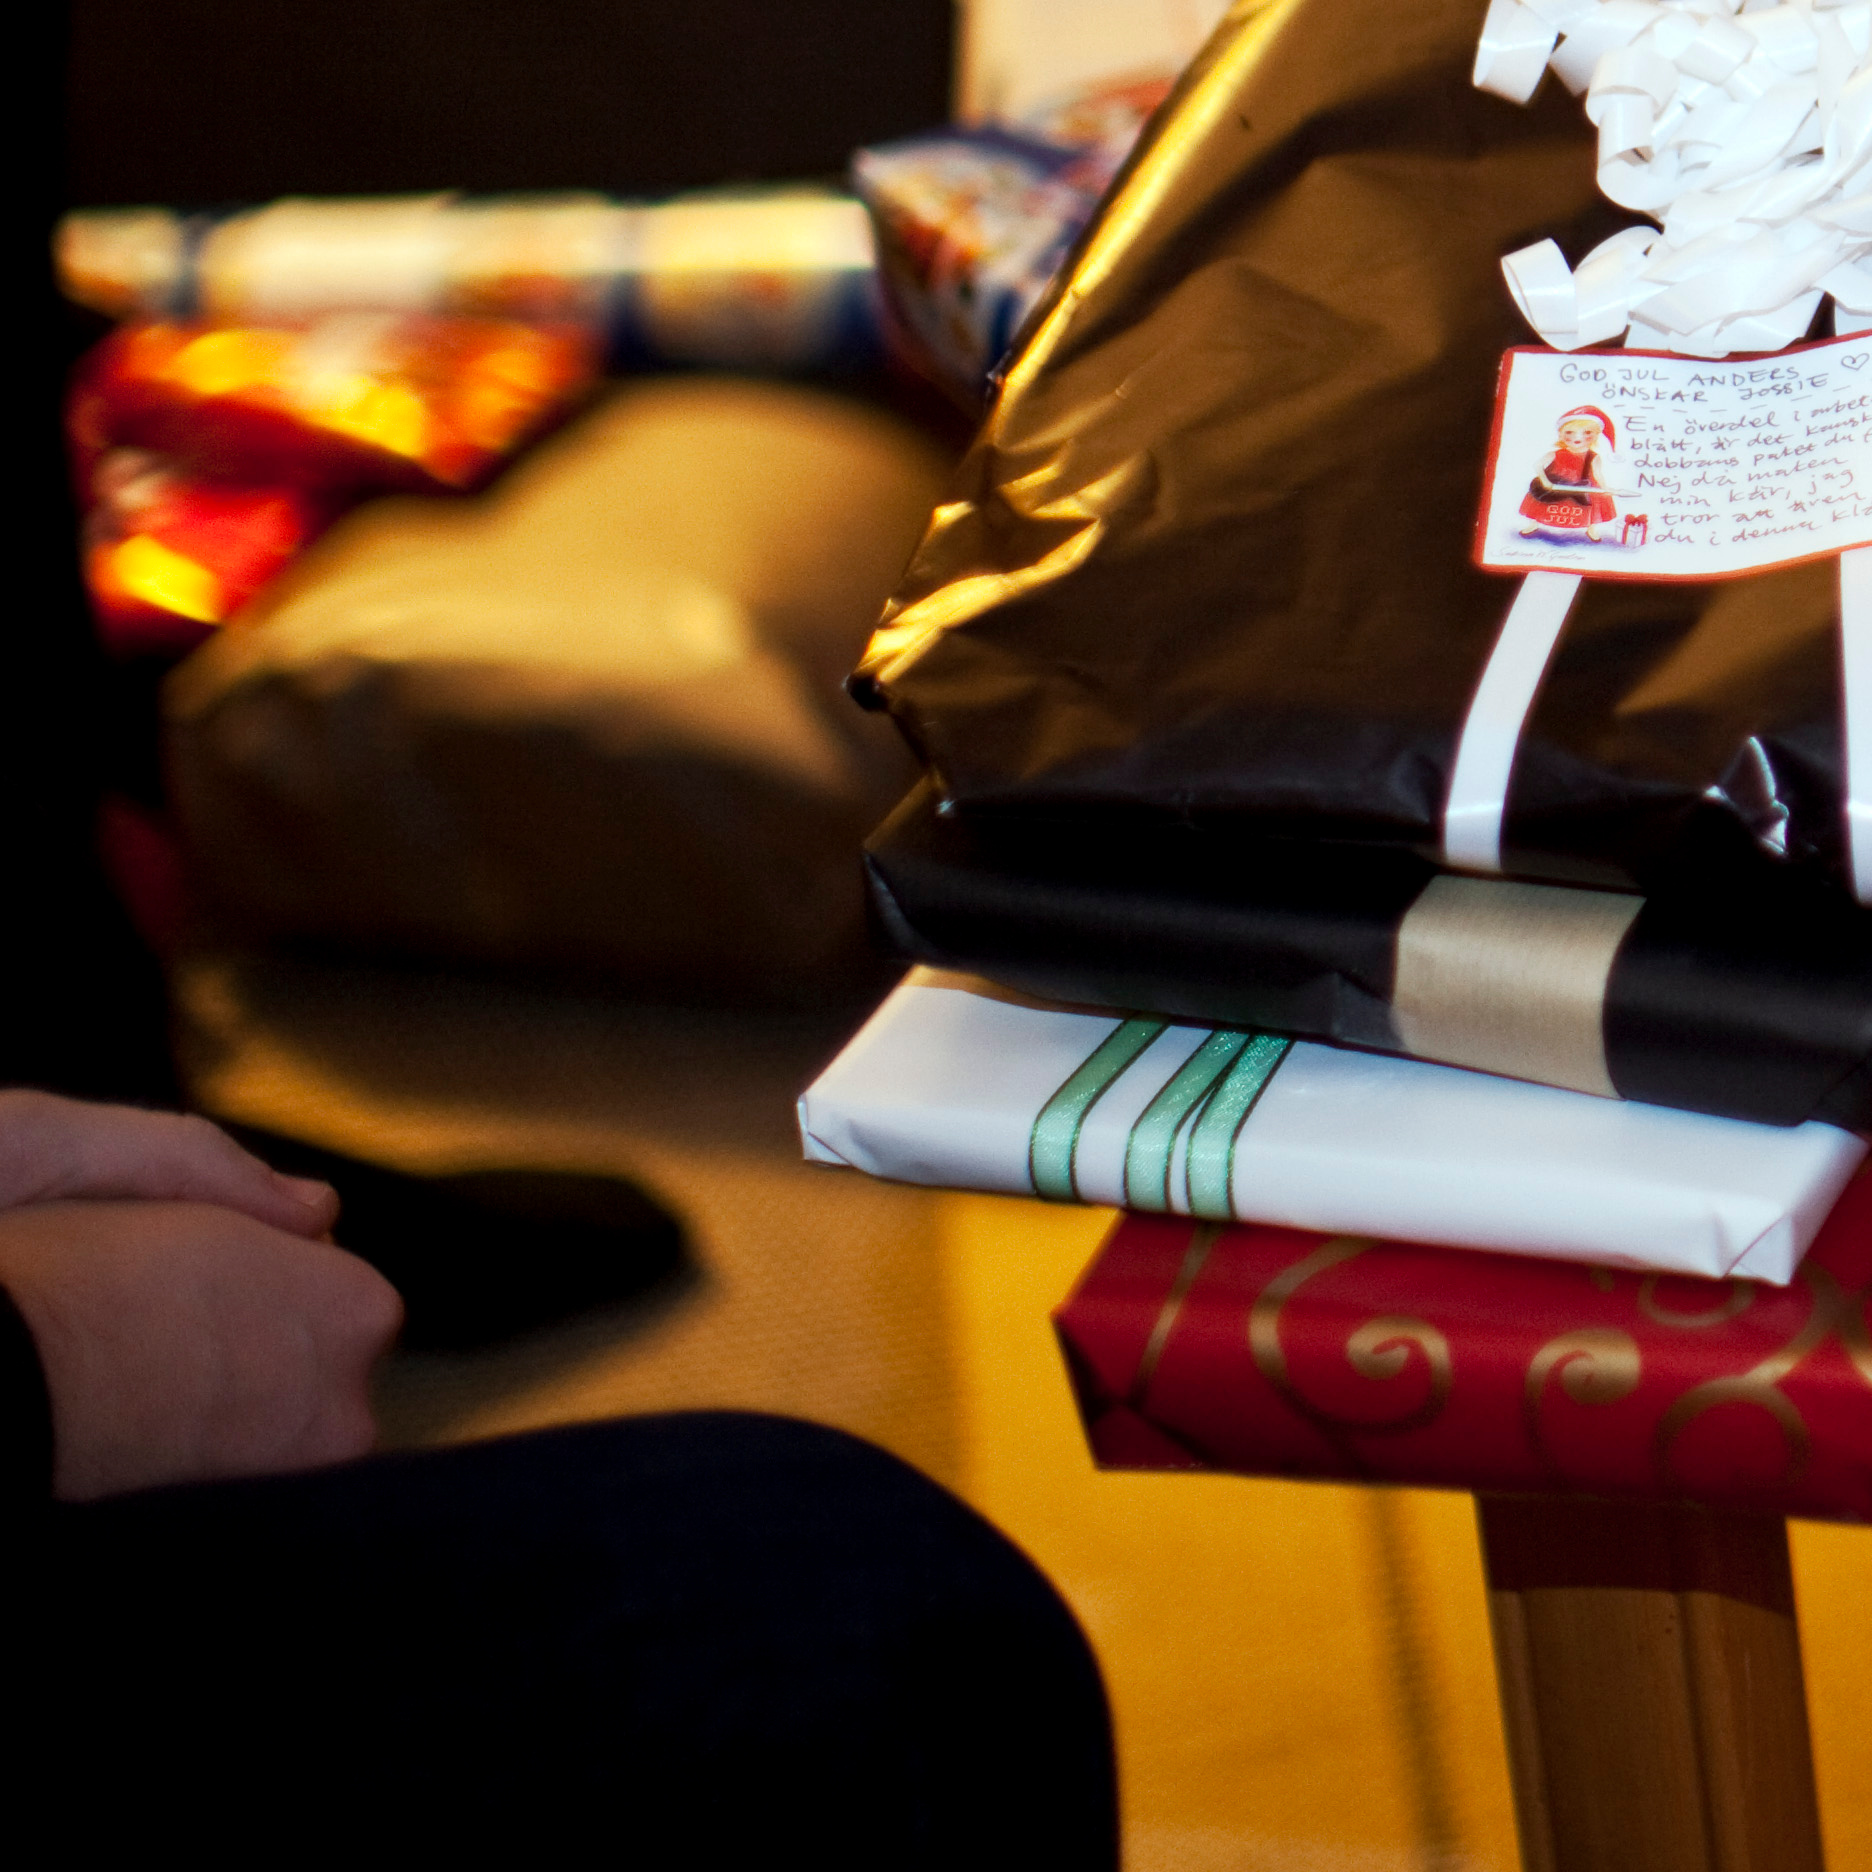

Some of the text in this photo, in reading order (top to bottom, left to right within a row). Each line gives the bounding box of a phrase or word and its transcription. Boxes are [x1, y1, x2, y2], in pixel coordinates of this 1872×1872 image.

[1560, 363, 1799, 387] GOD JUL ANDERS
[1603, 384, 1708, 402] ÖNSKAR
[1625, 416, 1664, 433] En
[1638, 472, 1681, 494] Nej
[1546, 504, 1583, 516] GOD
